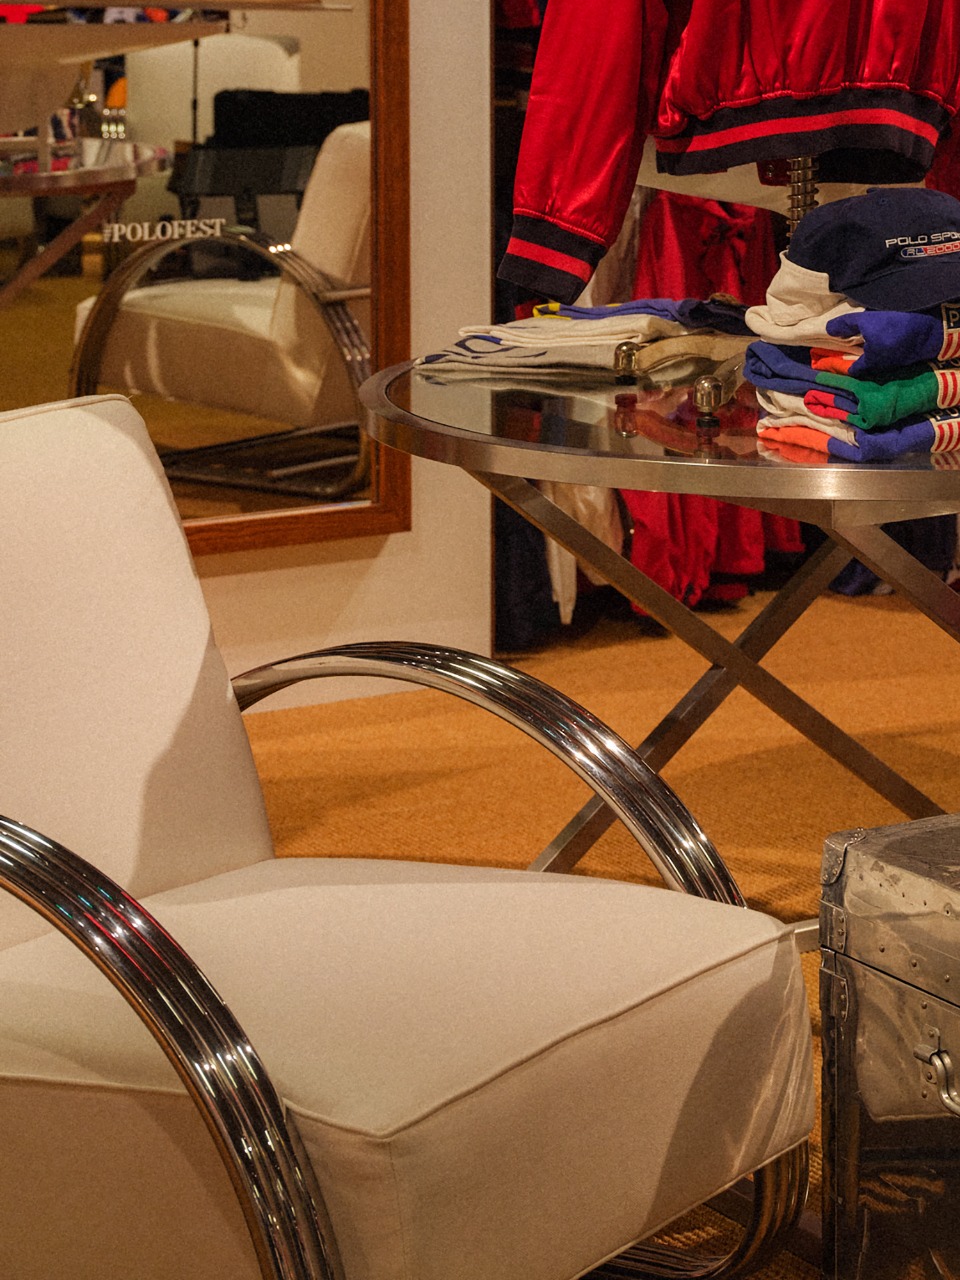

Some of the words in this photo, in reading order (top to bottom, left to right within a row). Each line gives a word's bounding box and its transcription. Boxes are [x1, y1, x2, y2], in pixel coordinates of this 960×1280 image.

[103, 218, 226, 243] #POLOFEST
[885, 235, 928, 249] POLO
[906, 243, 960, 257] RL2000
